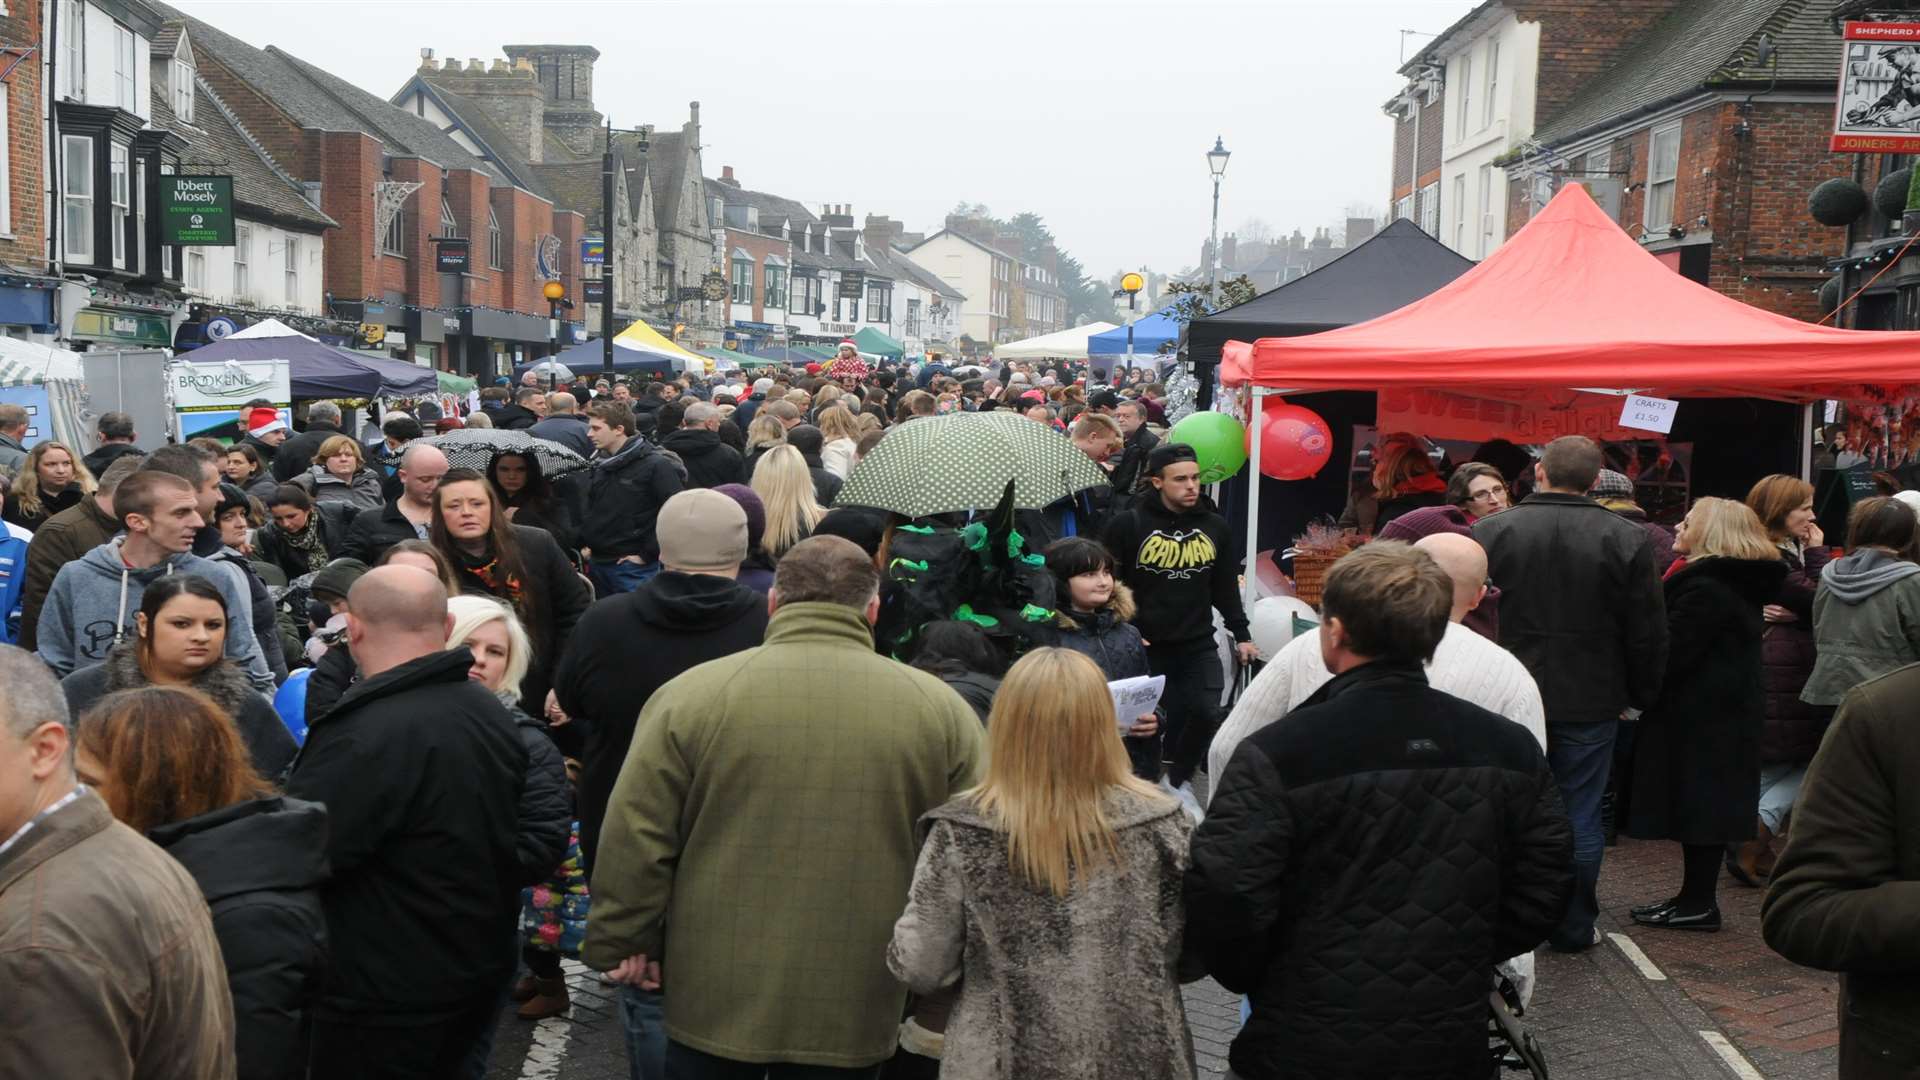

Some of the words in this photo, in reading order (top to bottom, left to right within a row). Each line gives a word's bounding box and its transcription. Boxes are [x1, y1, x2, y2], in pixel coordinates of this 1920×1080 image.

[1855, 27, 1914, 36] SHEPHERD
[1841, 139, 1897, 149] JOINERS
[177, 179, 214, 191] Ibbett
[174, 190, 217, 205] Mosely
[1635, 399, 1667, 410] CRAFTS
[1635, 412, 1659, 422] £1.50
[1139, 535, 1180, 568] BAD
[1179, 534, 1216, 568] MAN
